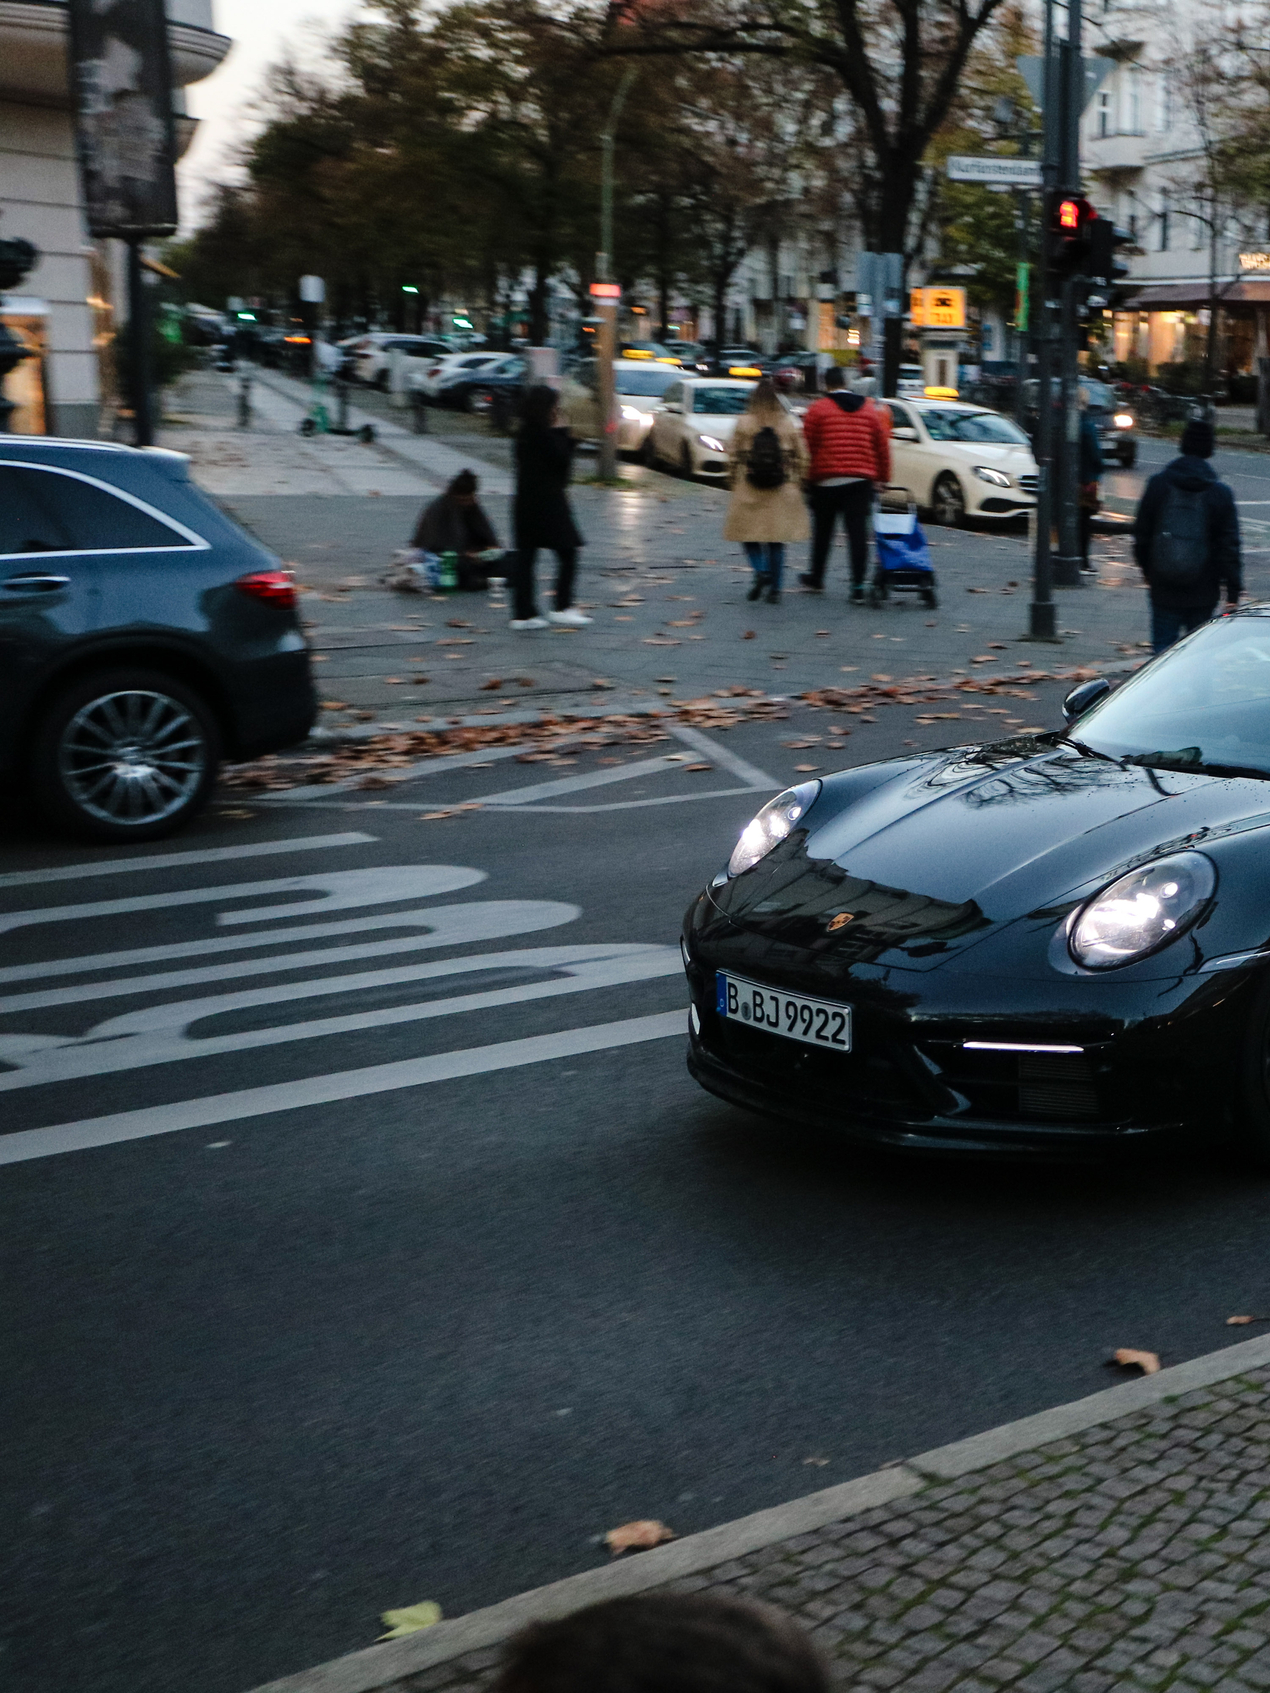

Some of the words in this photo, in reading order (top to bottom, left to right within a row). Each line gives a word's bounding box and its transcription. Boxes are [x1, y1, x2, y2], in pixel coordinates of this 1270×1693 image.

[727, 981, 739, 1014] B
[752, 990, 780, 1028] BJ
[785, 1000, 846, 1045] 9922
